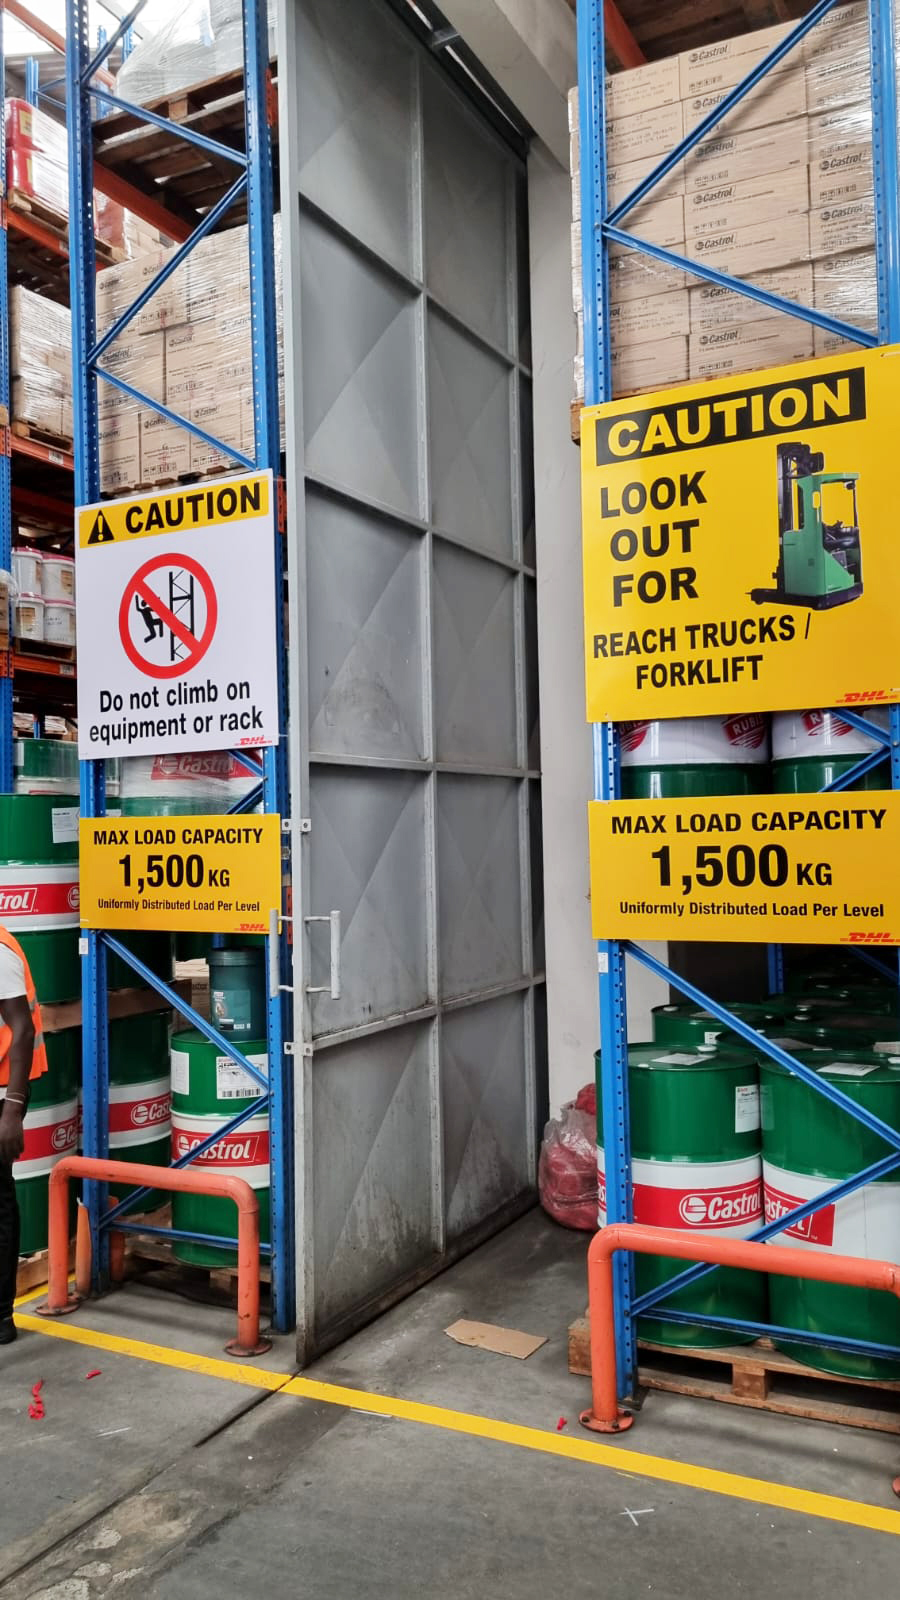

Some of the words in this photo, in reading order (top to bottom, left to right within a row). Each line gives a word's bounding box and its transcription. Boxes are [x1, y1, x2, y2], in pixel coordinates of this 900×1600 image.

[698, 45, 728, 61] Castrol
[703, 95, 724, 107] Castr
[703, 140, 734, 157] Castrol
[830, 153, 863, 169] Castrol
[703, 187, 733, 203] Castrol
[831, 204, 863, 220] Castrol
[703, 234, 734, 250] Castrol
[708, 330, 738, 345] Castrol
[607, 378, 850, 457] CAUTION
[600, 470, 707, 518] LOOK
[125, 482, 260, 533] CAUTION
[610, 518, 700, 562] OUT
[612, 566, 699, 608] FOR
[593, 626, 677, 659] REACH
[685, 614, 796, 650] TRUCKS
[805, 612, 812, 640] /
[636, 654, 764, 690] FORKLIFT
[100, 690, 123, 713] Do
[130, 686, 160, 710] not
[166, 679, 218, 707] climb
[227, 681, 250, 700] on
[843, 690, 889, 703] DHL
[89, 712, 187, 746] equipment
[193, 711, 213, 732] or
[220, 705, 264, 733] rack
[611, 815, 667, 835] MAX
[676, 813, 742, 833] LOAD
[751, 809, 887, 832] CAPACITY
[93, 830, 129, 846] MAX
[134, 829, 176, 845] LOAD
[181, 828, 263, 844] CAPACITY
[118, 853, 205, 894] 1,500
[208, 869, 230, 887] KG
[651, 843, 789, 895] 1,500
[796, 862, 833, 886] KG
[0, 891, 30, 910] trol
[98, 898, 139, 911] Uniformly
[142, 898, 190, 911] Distributed
[193, 900, 214, 911] Load
[217, 900, 232, 911] Per
[235, 901, 260, 912] Level
[619, 901, 685, 917] Uniformly
[689, 902, 767, 916] Distributed
[772, 903, 807, 916] Load
[813, 904, 837, 917] Per
[843, 904, 885, 917] Level
[848, 932, 894, 943] DHL
[708, 1187, 761, 1221] Castrol
